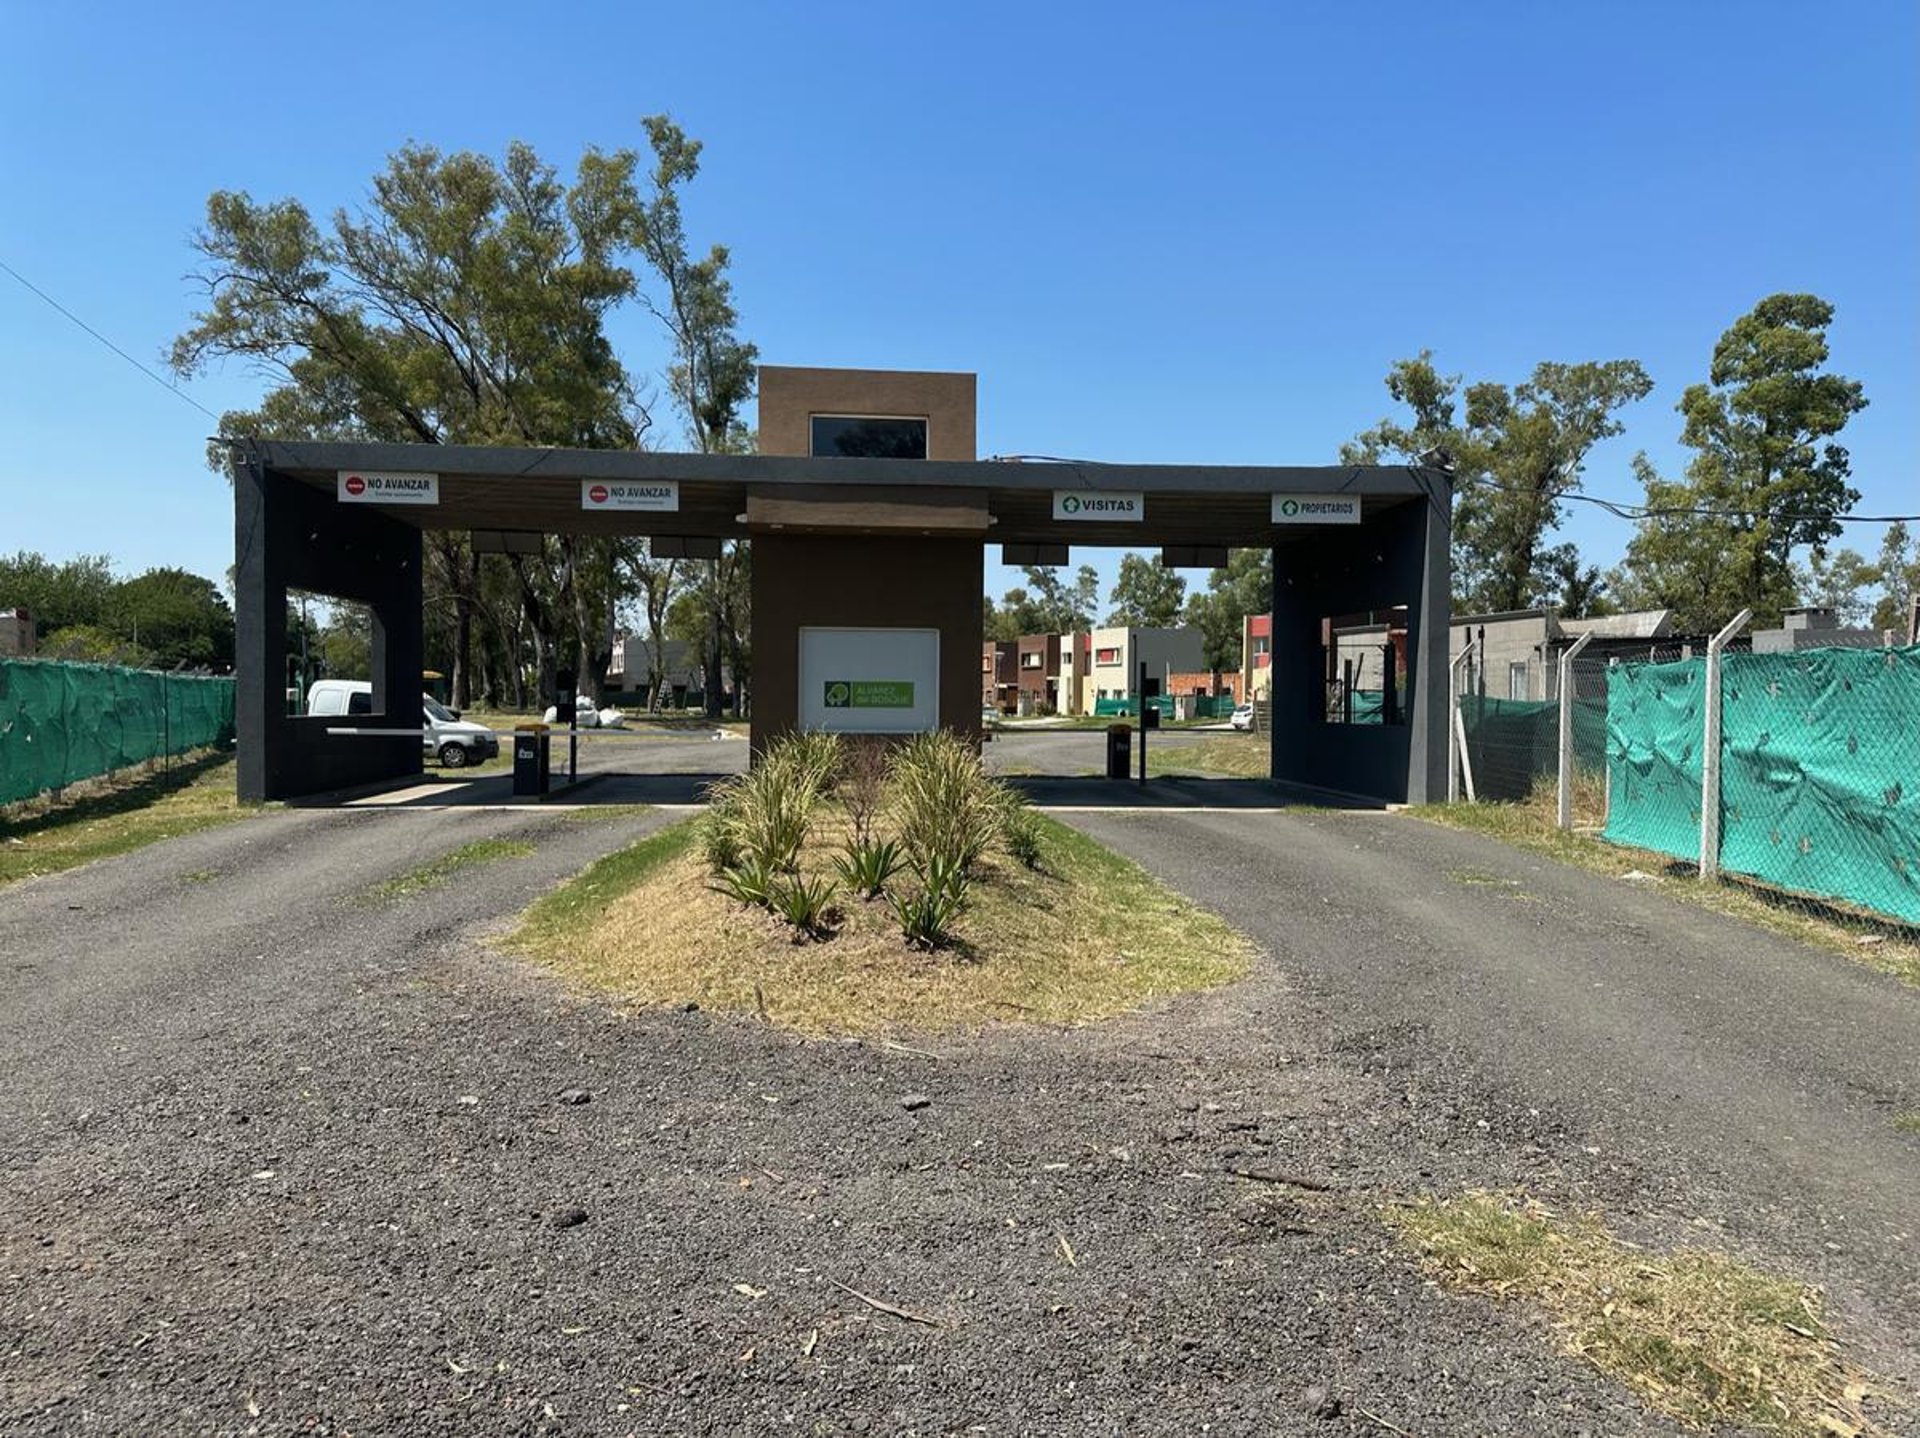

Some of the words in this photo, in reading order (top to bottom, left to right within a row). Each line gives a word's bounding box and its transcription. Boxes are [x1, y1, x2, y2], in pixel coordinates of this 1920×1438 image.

[368, 478, 382, 489] NO
[385, 479, 430, 491] AVANZAR
[611, 486, 625, 498] NO
[627, 487, 671, 498] AVANZAR
[1082, 499, 1134, 511] VISITAS
[1300, 502, 1353, 514] PROPIETARIOS
